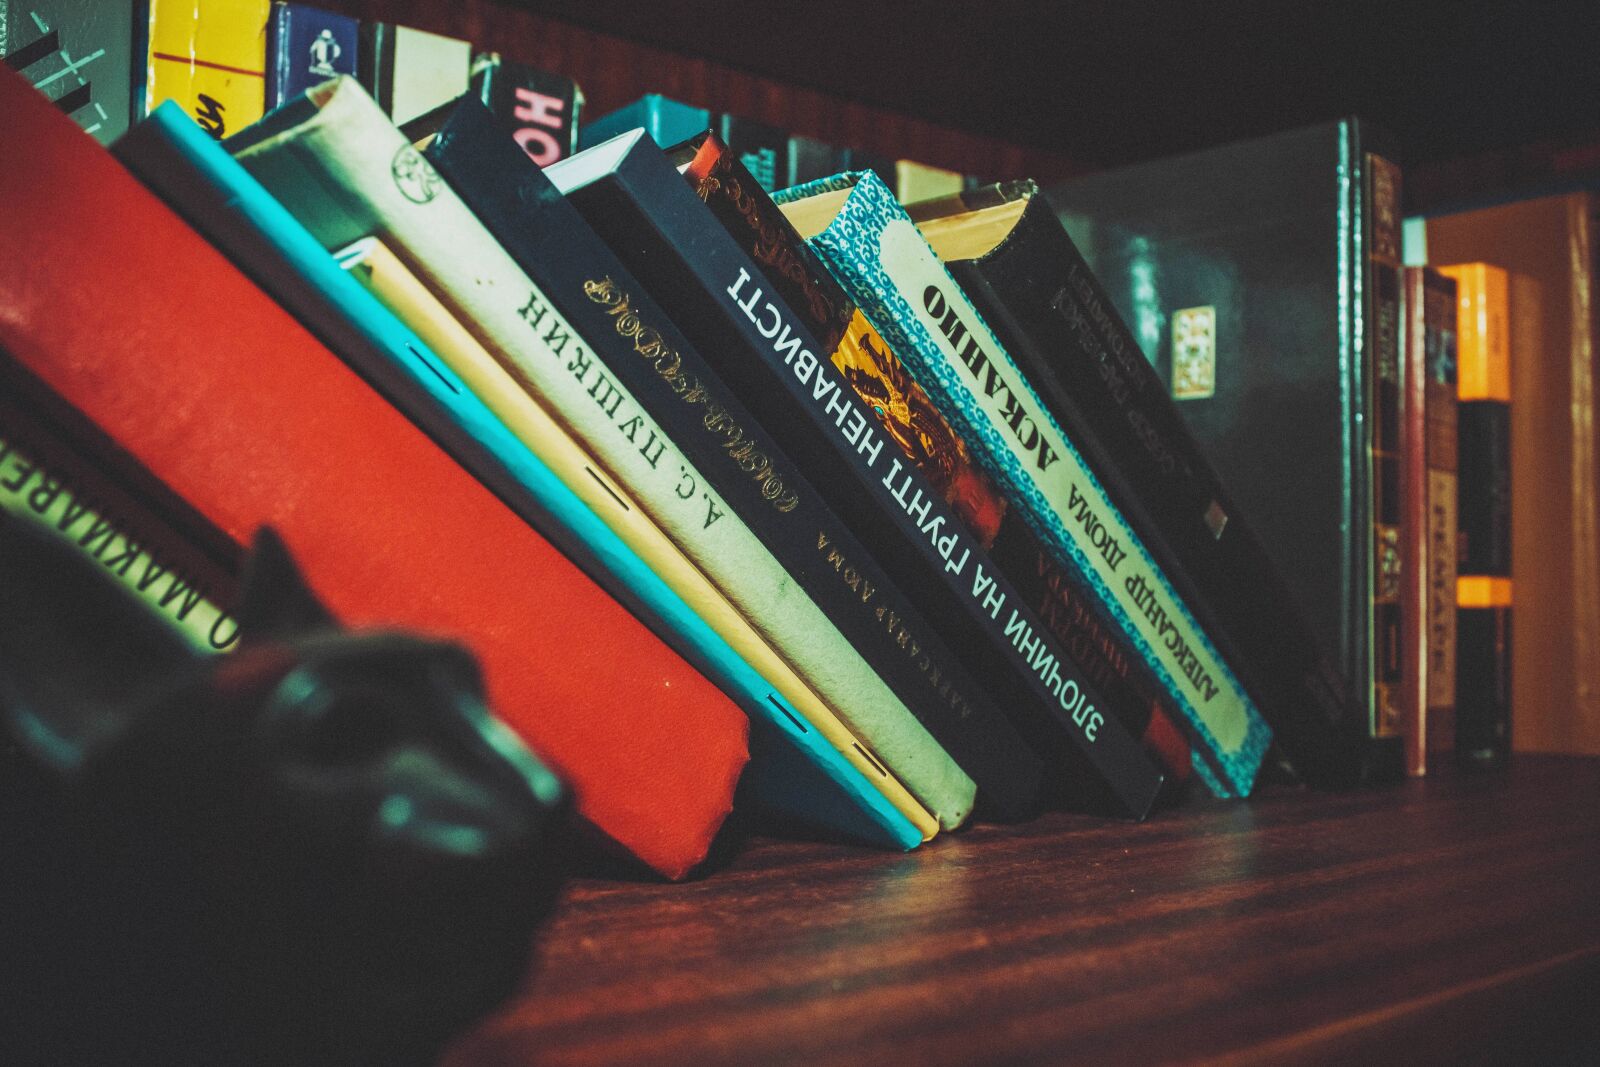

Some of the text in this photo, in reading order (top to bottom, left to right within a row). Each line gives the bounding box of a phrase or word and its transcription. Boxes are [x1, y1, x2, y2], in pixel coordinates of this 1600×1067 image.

[517, 291, 667, 470] ПУШКИН
[726, 266, 884, 468] НЕНАВИСТІ
[923, 284, 1060, 473] АСКАНИО
[0, 447, 203, 623] МАКИАВЕ
[882, 457, 970, 575] ҐРУНТІ
[1067, 482, 1127, 572] ДЮМА
[972, 563, 1006, 620] НА
[1124, 573, 1221, 702] АЛЕКСАНДР
[1003, 609, 1104, 743] ЗЛОЧИНИ
